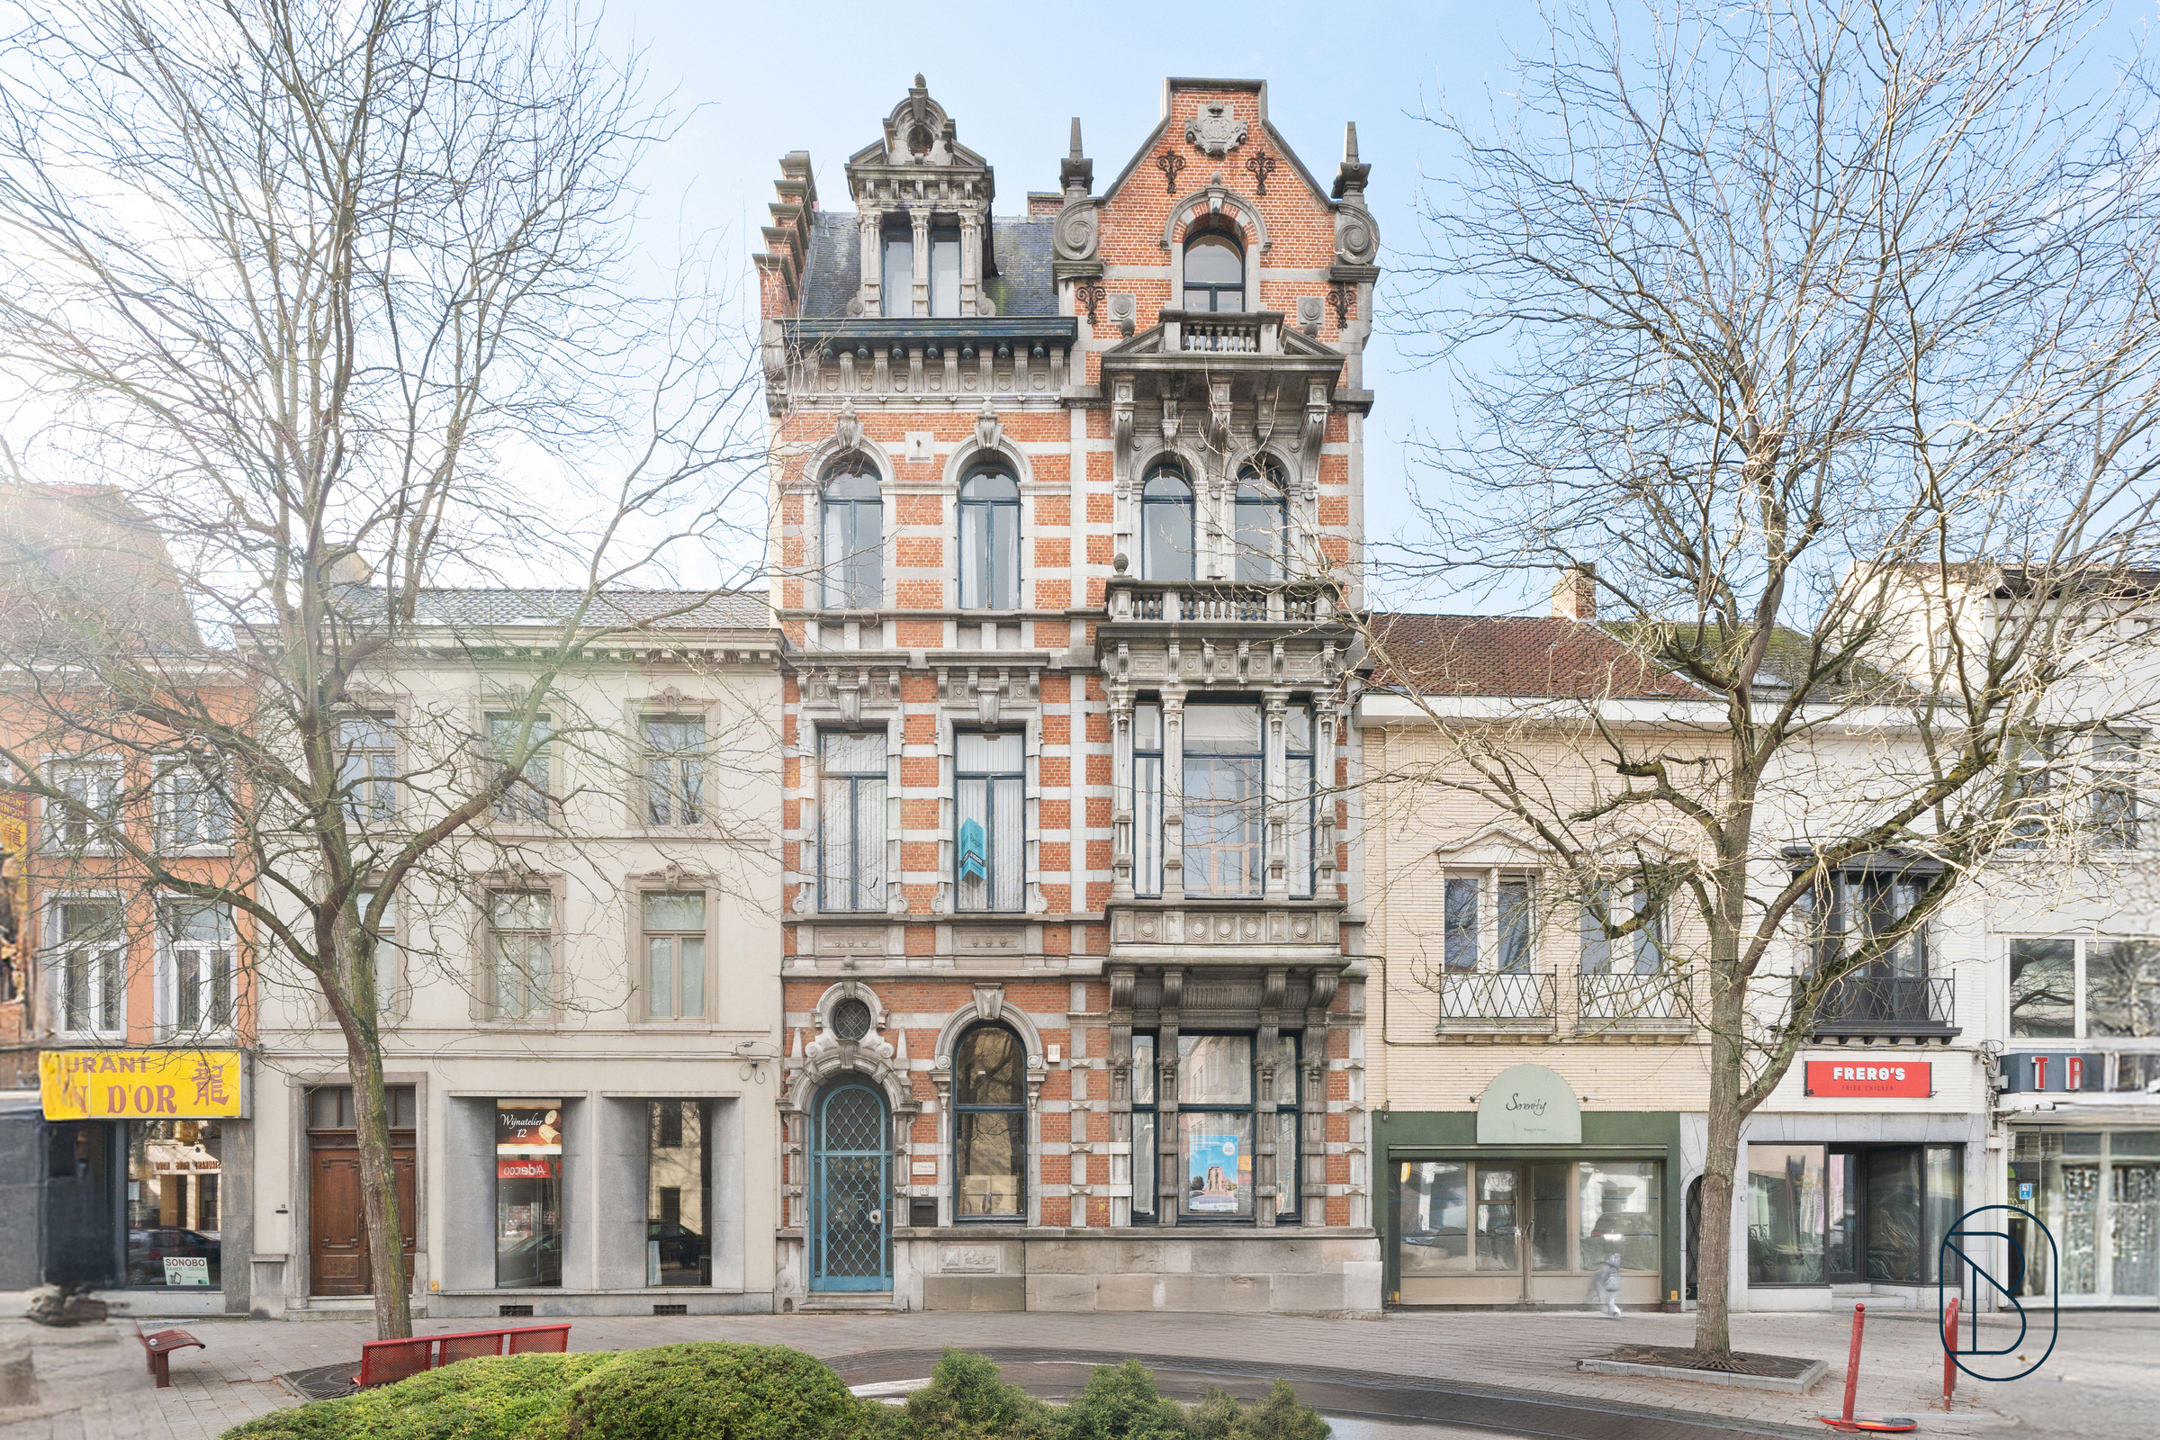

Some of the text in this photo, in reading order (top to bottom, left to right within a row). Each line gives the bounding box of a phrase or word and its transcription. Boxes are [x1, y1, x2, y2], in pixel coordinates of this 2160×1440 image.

[107, 1084, 178, 1114] D'OR
[1505, 1092, 1547, 1116] Serenity
[500, 1112, 543, 1130] Wijnatelier
[517, 1128, 527, 1138] 12
[165, 1258, 206, 1267] SONOBO
